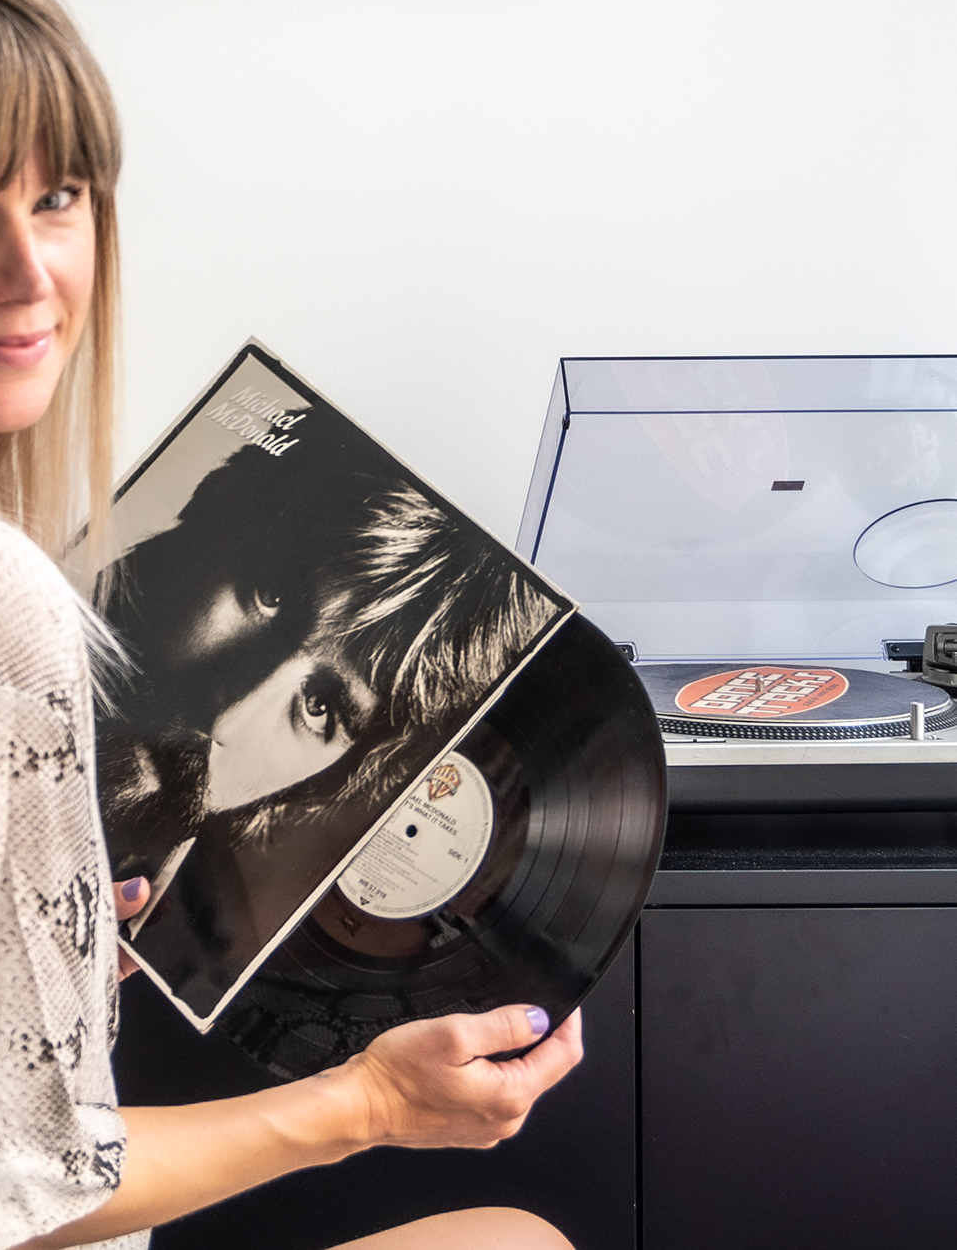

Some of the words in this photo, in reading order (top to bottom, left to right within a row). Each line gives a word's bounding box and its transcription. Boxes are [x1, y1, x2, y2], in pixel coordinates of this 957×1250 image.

[229, 385, 307, 431] Michael
[205, 402, 300, 457] McDonald
[688, 671, 786, 710] DANCE
[411, 795, 423, 805] AEL
[423, 802, 457, 826] MCDONALD
[413, 806, 431, 820] WHAT
[430, 816, 438, 824] IT
[438, 821, 458, 836] TAKES
[447, 848, 462, 861] SIDE
